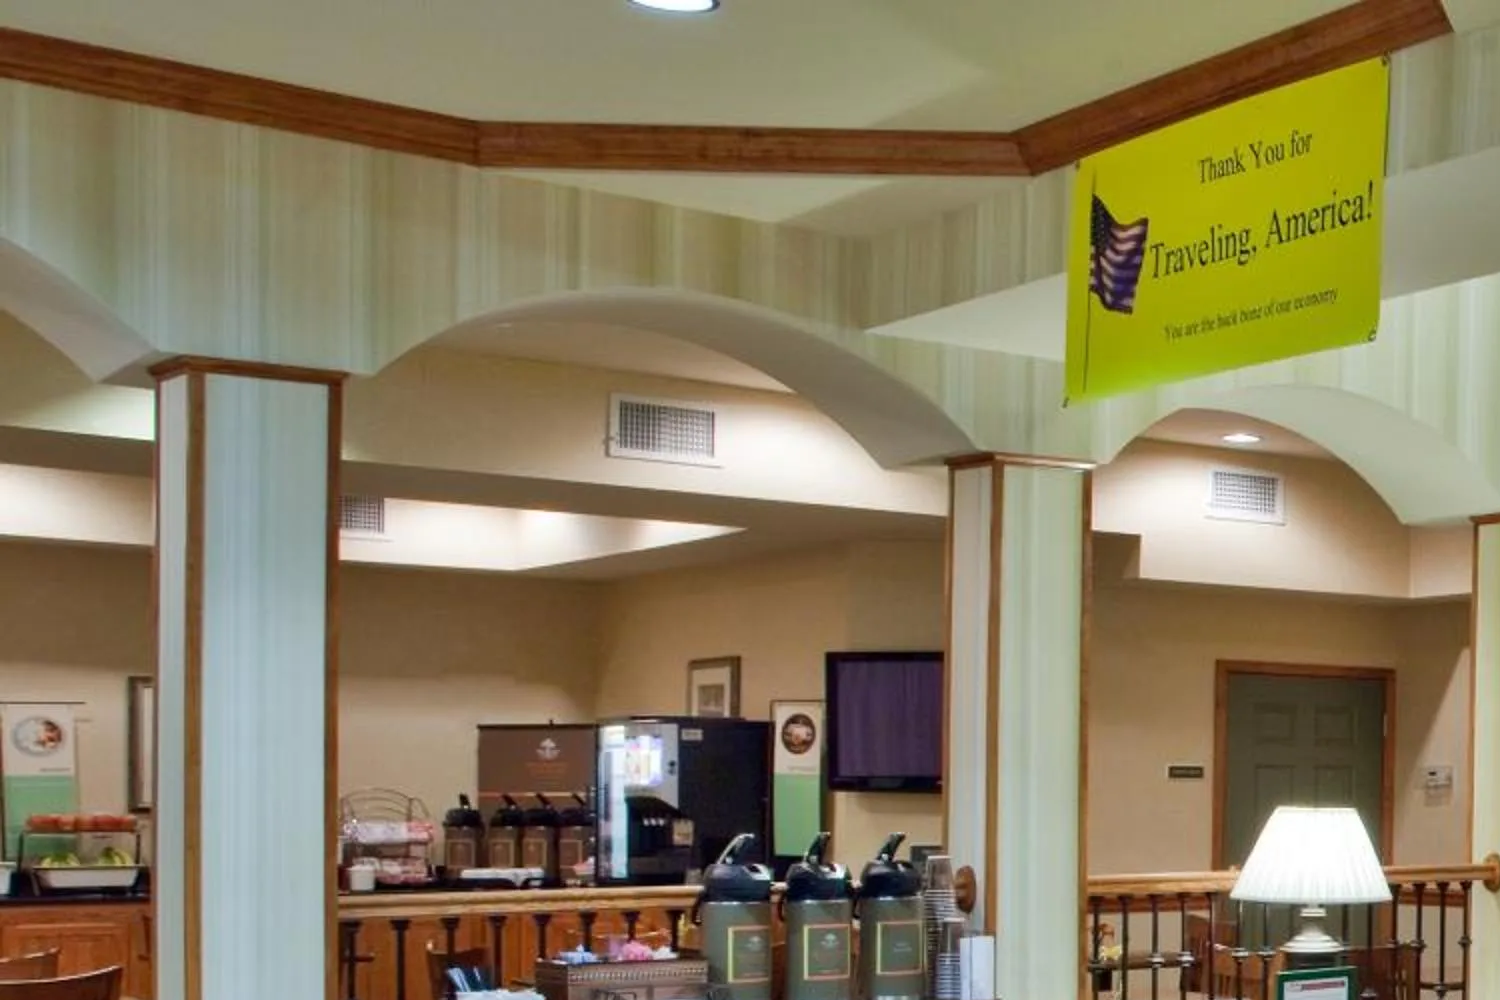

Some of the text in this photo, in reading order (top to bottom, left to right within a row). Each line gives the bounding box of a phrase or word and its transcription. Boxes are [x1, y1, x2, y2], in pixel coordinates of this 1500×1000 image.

[1199, 129, 1313, 184] Thank You for
[1150, 179, 1374, 279] Traveling, America!
